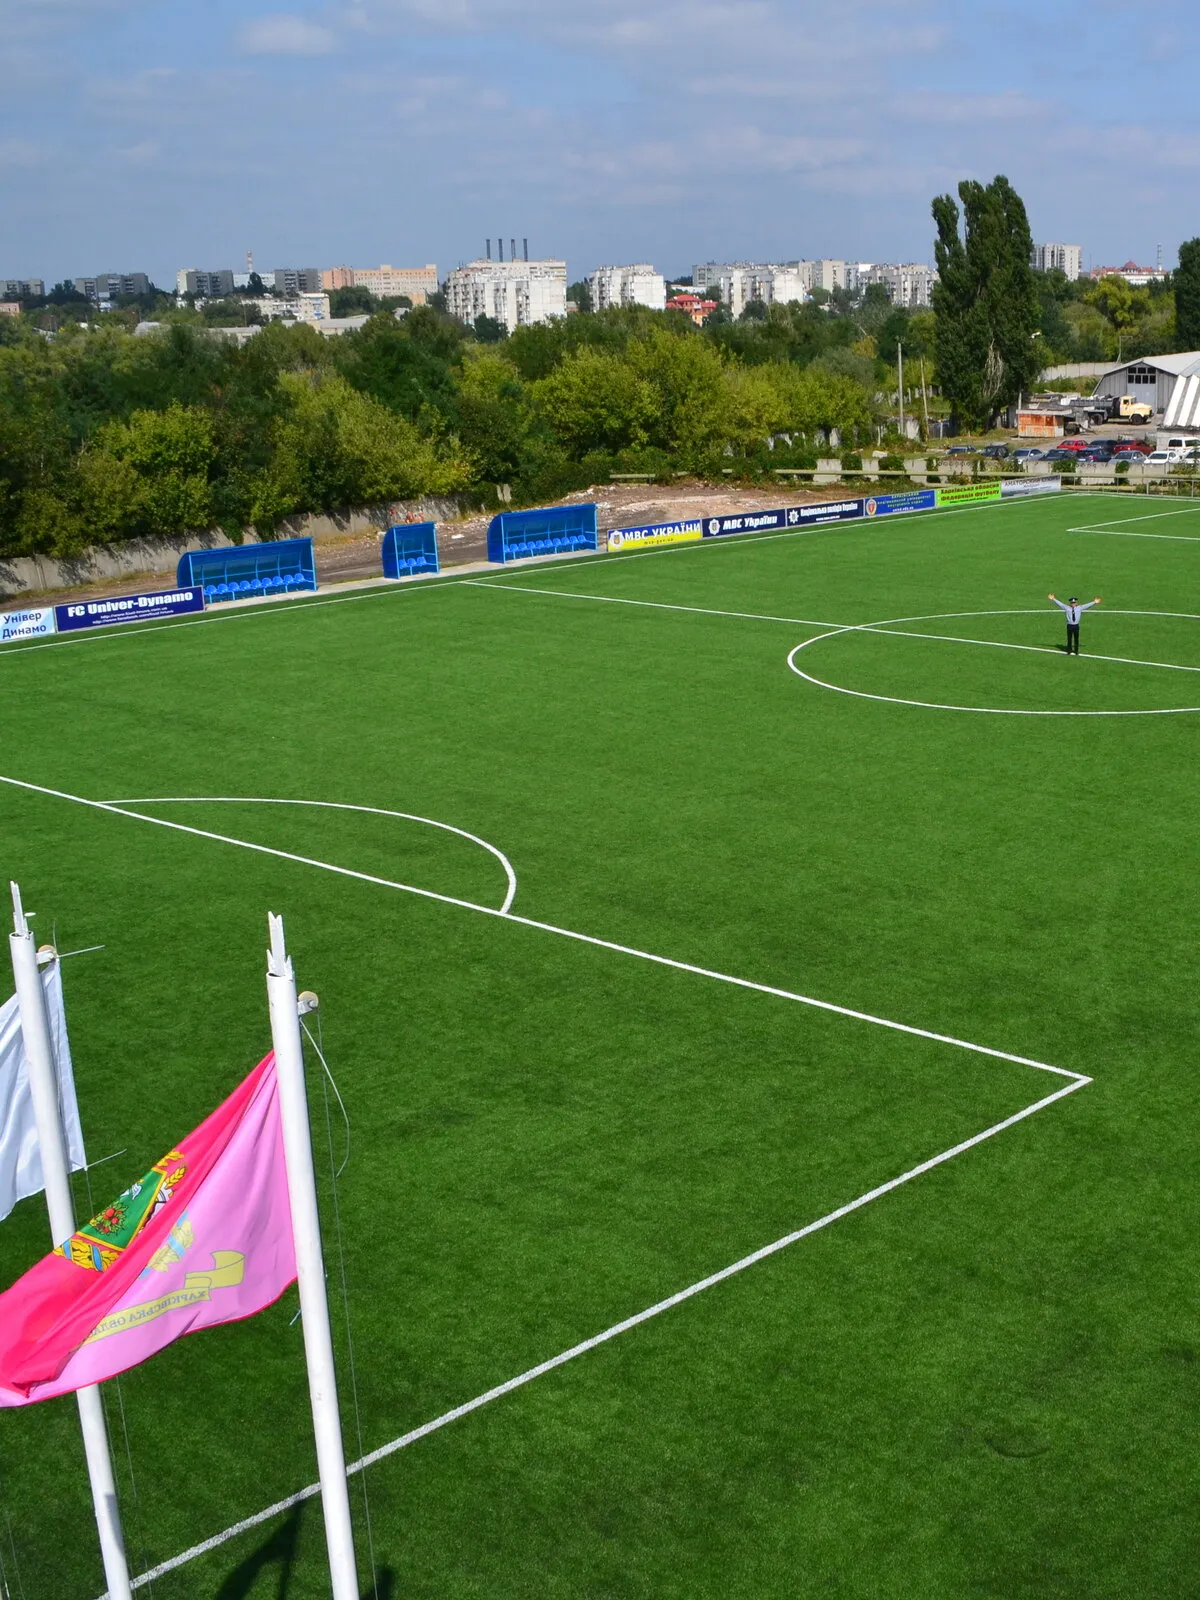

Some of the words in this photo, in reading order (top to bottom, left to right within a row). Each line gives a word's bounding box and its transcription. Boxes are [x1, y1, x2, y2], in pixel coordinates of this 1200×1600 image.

[723, 518, 743, 531] МВС
[744, 515, 778, 529] України
[624, 530, 649, 542] МВС
[652, 522, 701, 539] УКРАЇНИ
[67, 606, 86, 618] FC
[88, 592, 194, 614] Univer-Dynamo
[3, 612, 42, 625] Універ
[2, 625, 47, 639] Динамо
